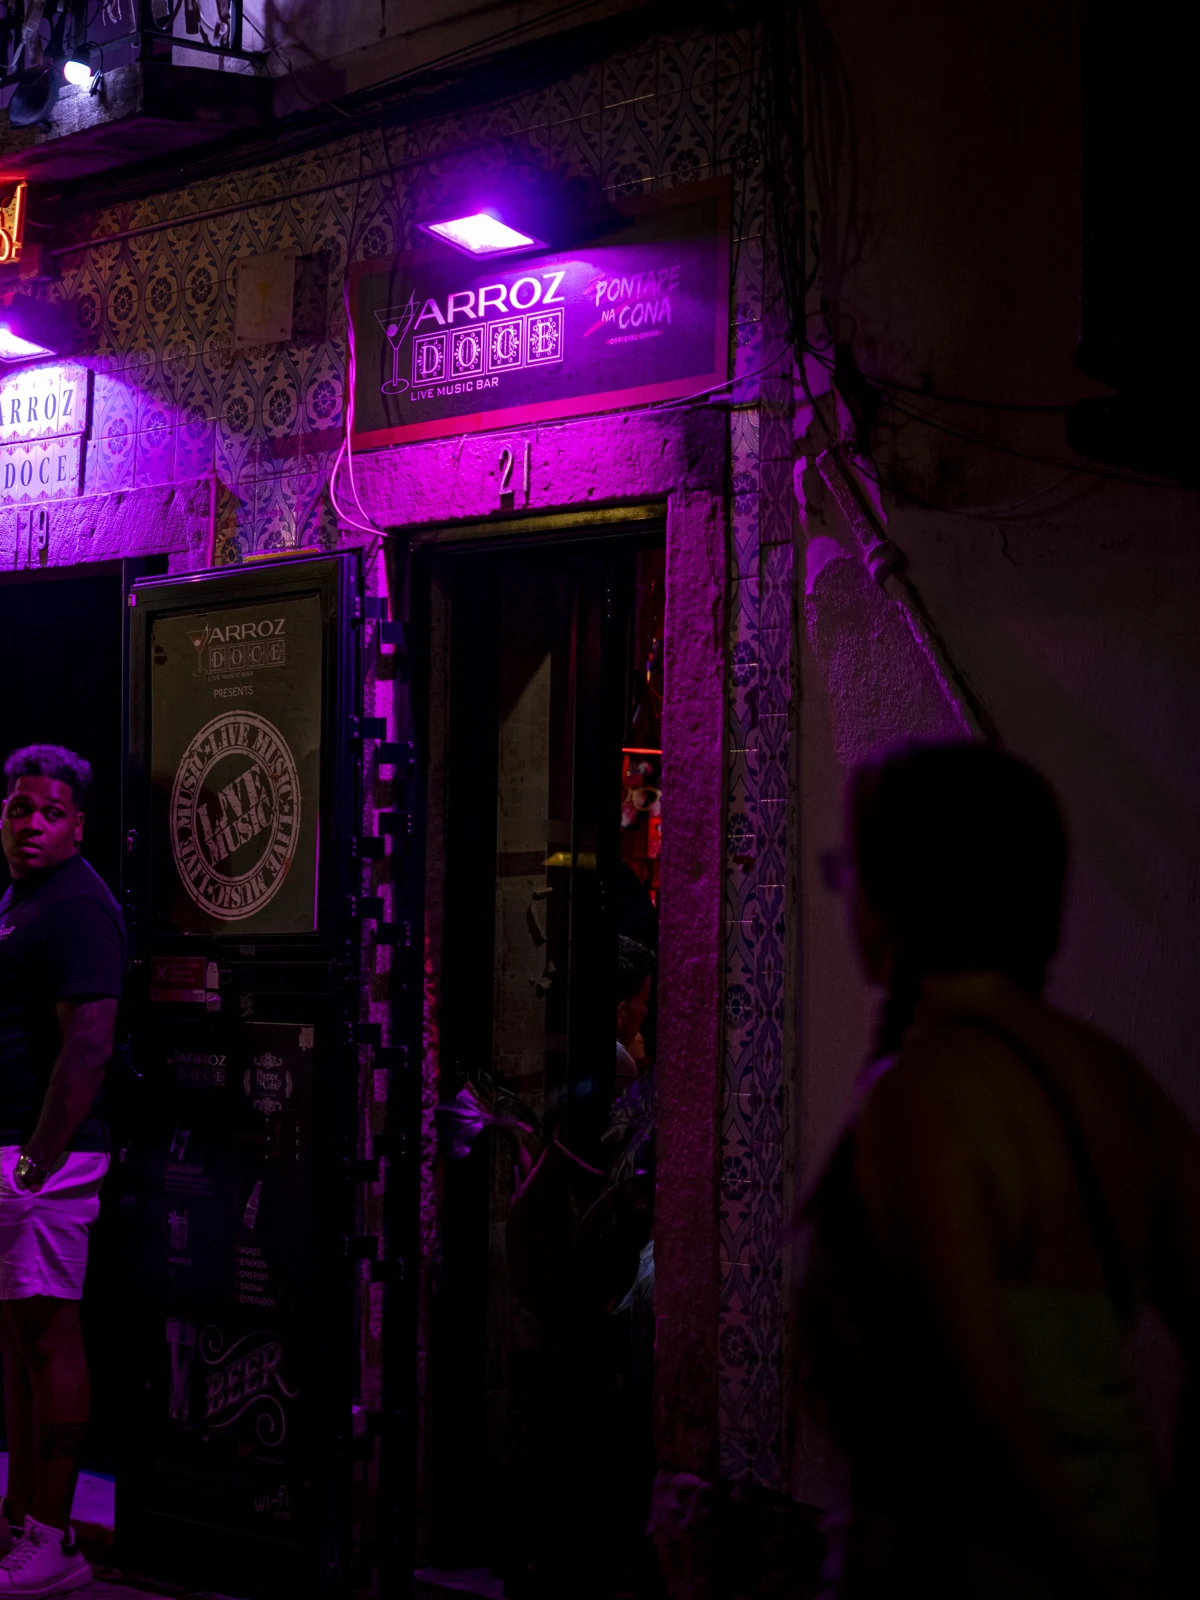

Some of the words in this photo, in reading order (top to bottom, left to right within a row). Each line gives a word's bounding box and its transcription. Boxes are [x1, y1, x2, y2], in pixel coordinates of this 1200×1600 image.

[413, 270, 565, 330] ARROZ
[595, 258, 681, 308] PONTAPÉ
[601, 308, 616, 322] NA
[618, 296, 671, 330] CONA
[416, 313, 560, 382] DOCE
[610, 333, 638, 345] OFFICIAL
[410, 388, 434, 401] LIVE
[437, 381, 473, 397] MUSIC
[477, 376, 499, 391] BAR
[3, 455, 68, 490] DOCE
[498, 440, 531, 496] 21
[208, 618, 286, 644] ARROZ
[211, 642, 283, 671] DOCE
[208, 674, 220, 682] LIVE
[221, 671, 240, 680] MUSIC
[241, 670, 254, 678] BAR
[213, 685, 254, 698] PRESENTS
[207, 723, 250, 751] LIVE
[252, 728, 293, 799] MUSIC
[177, 750, 208, 829] MUSIC
[197, 763, 270, 843] LIVE
[206, 799, 275, 868] MUSIC
[265, 814, 294, 878] LIVE
[179, 836, 211, 896] LIVE
[212, 870, 269, 909] MUSIC
[176, 1052, 227, 1067] ARROZ
[177, 1068, 224, 1083] DOCE
[237, 1245, 261, 1257] AGRES
[237, 1257, 268, 1269] EINEKEN
[237, 1294, 276, 1308] ESPERADOS
[204, 1341, 294, 1419] BEER
